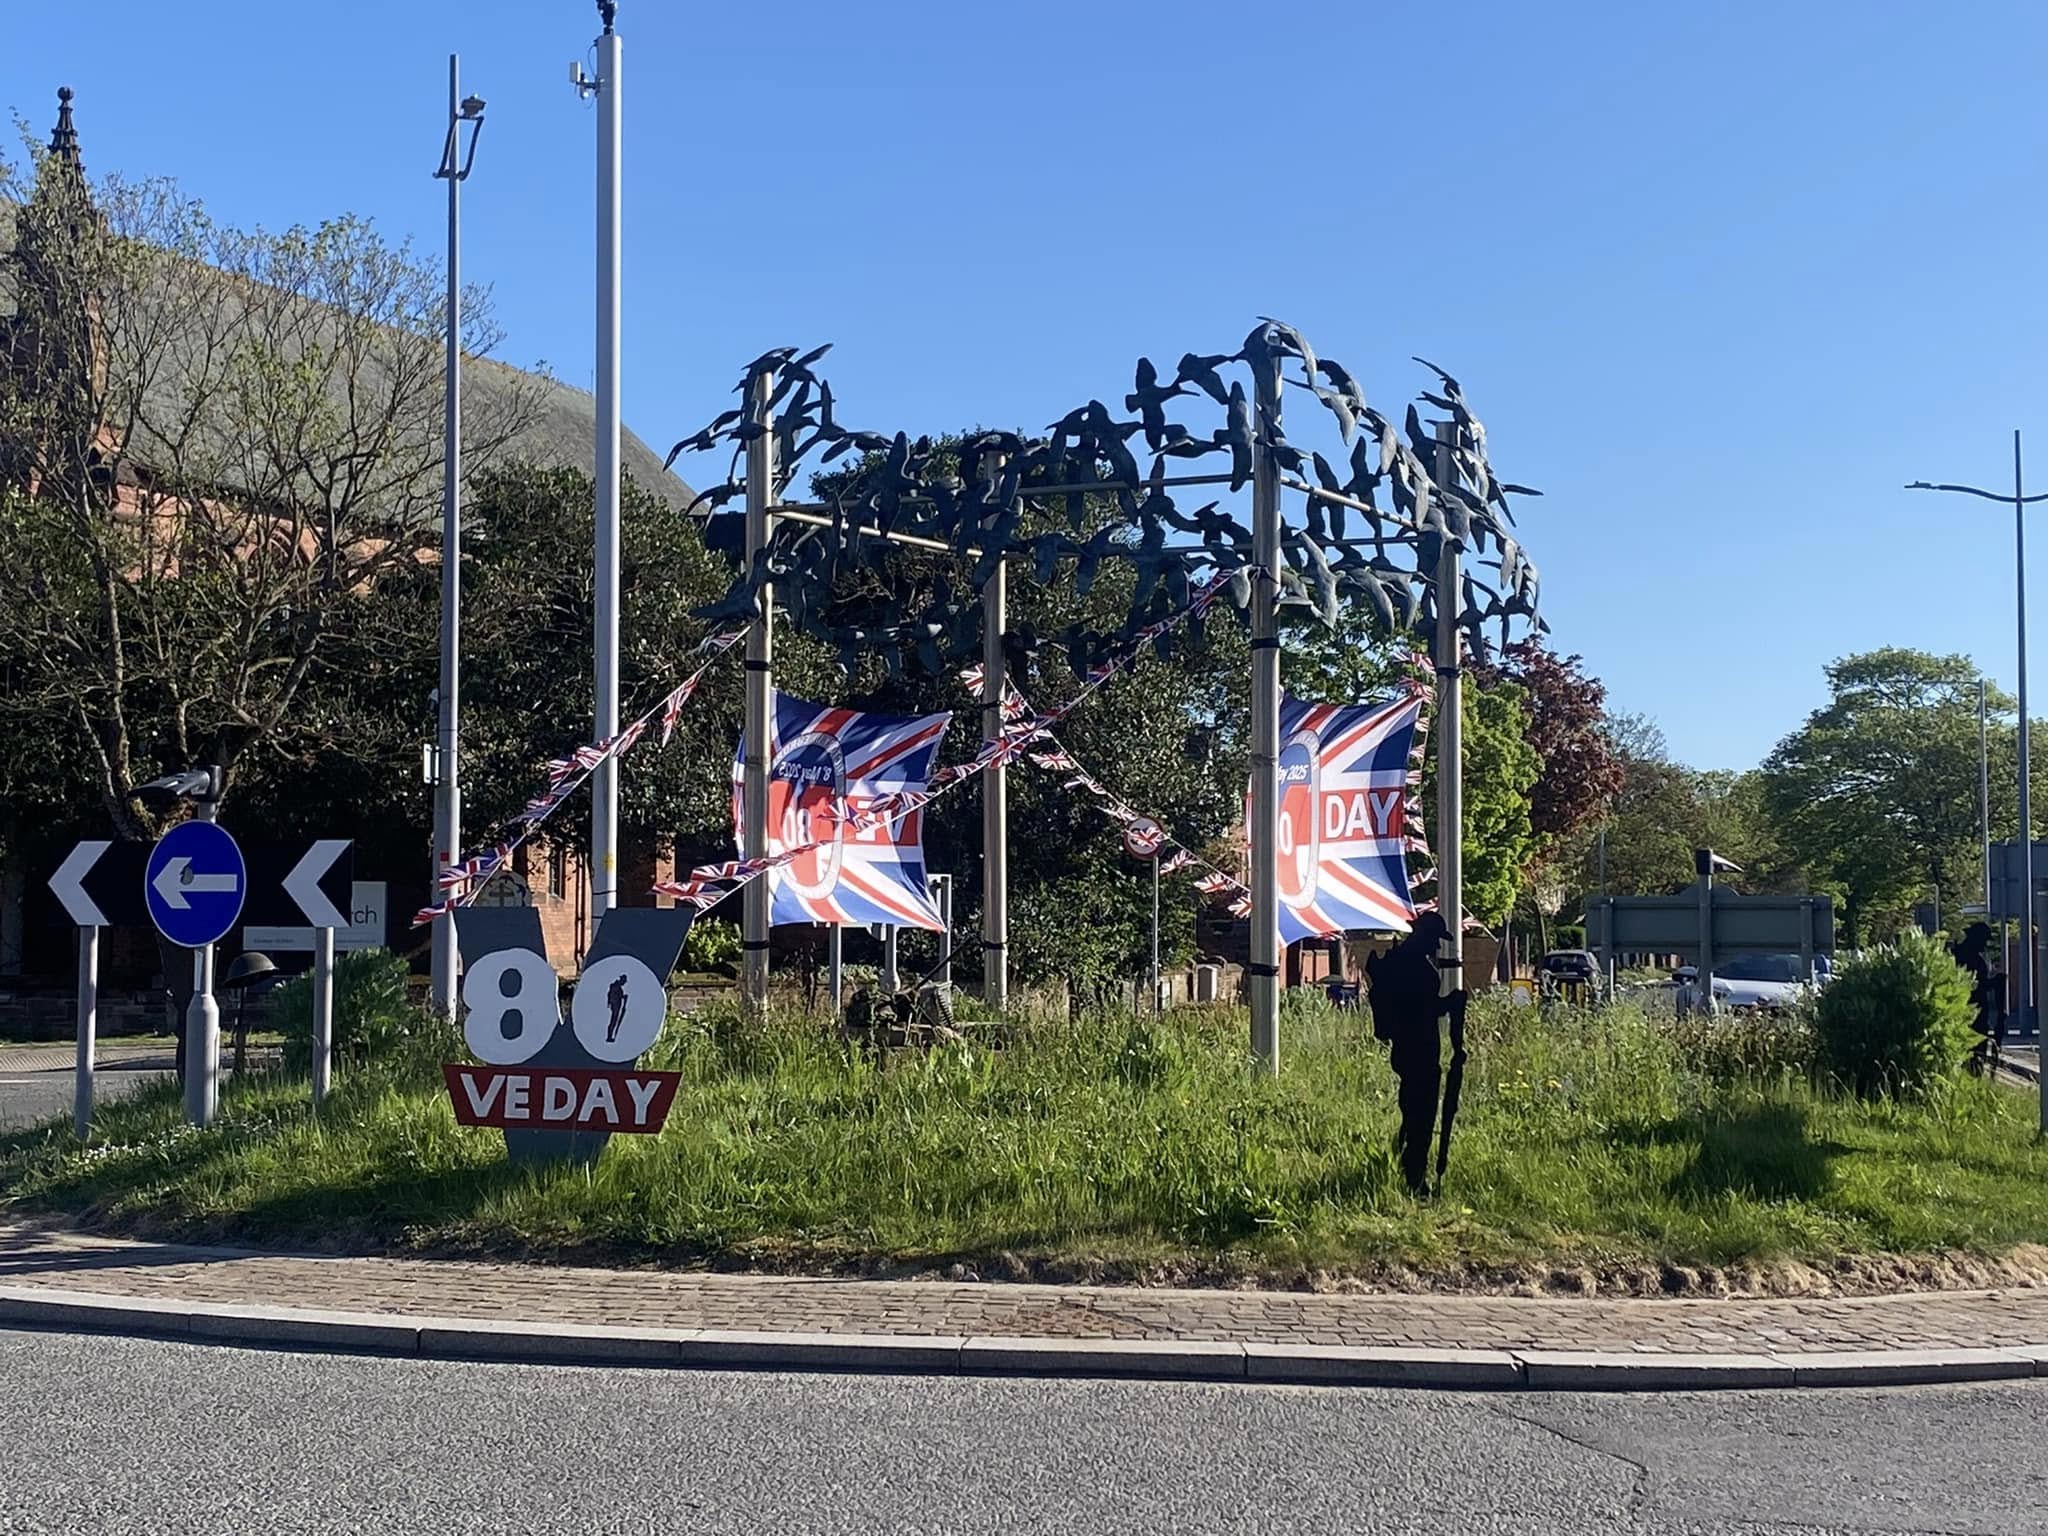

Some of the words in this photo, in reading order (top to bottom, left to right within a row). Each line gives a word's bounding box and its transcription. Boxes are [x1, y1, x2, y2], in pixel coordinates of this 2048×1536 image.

[1287, 764, 1309, 781] 2025
[1325, 791, 1400, 839] DAY
[463, 948, 667, 1065] 80
[460, 1073, 530, 1119] VE
[542, 1076, 662, 1125] DAY
